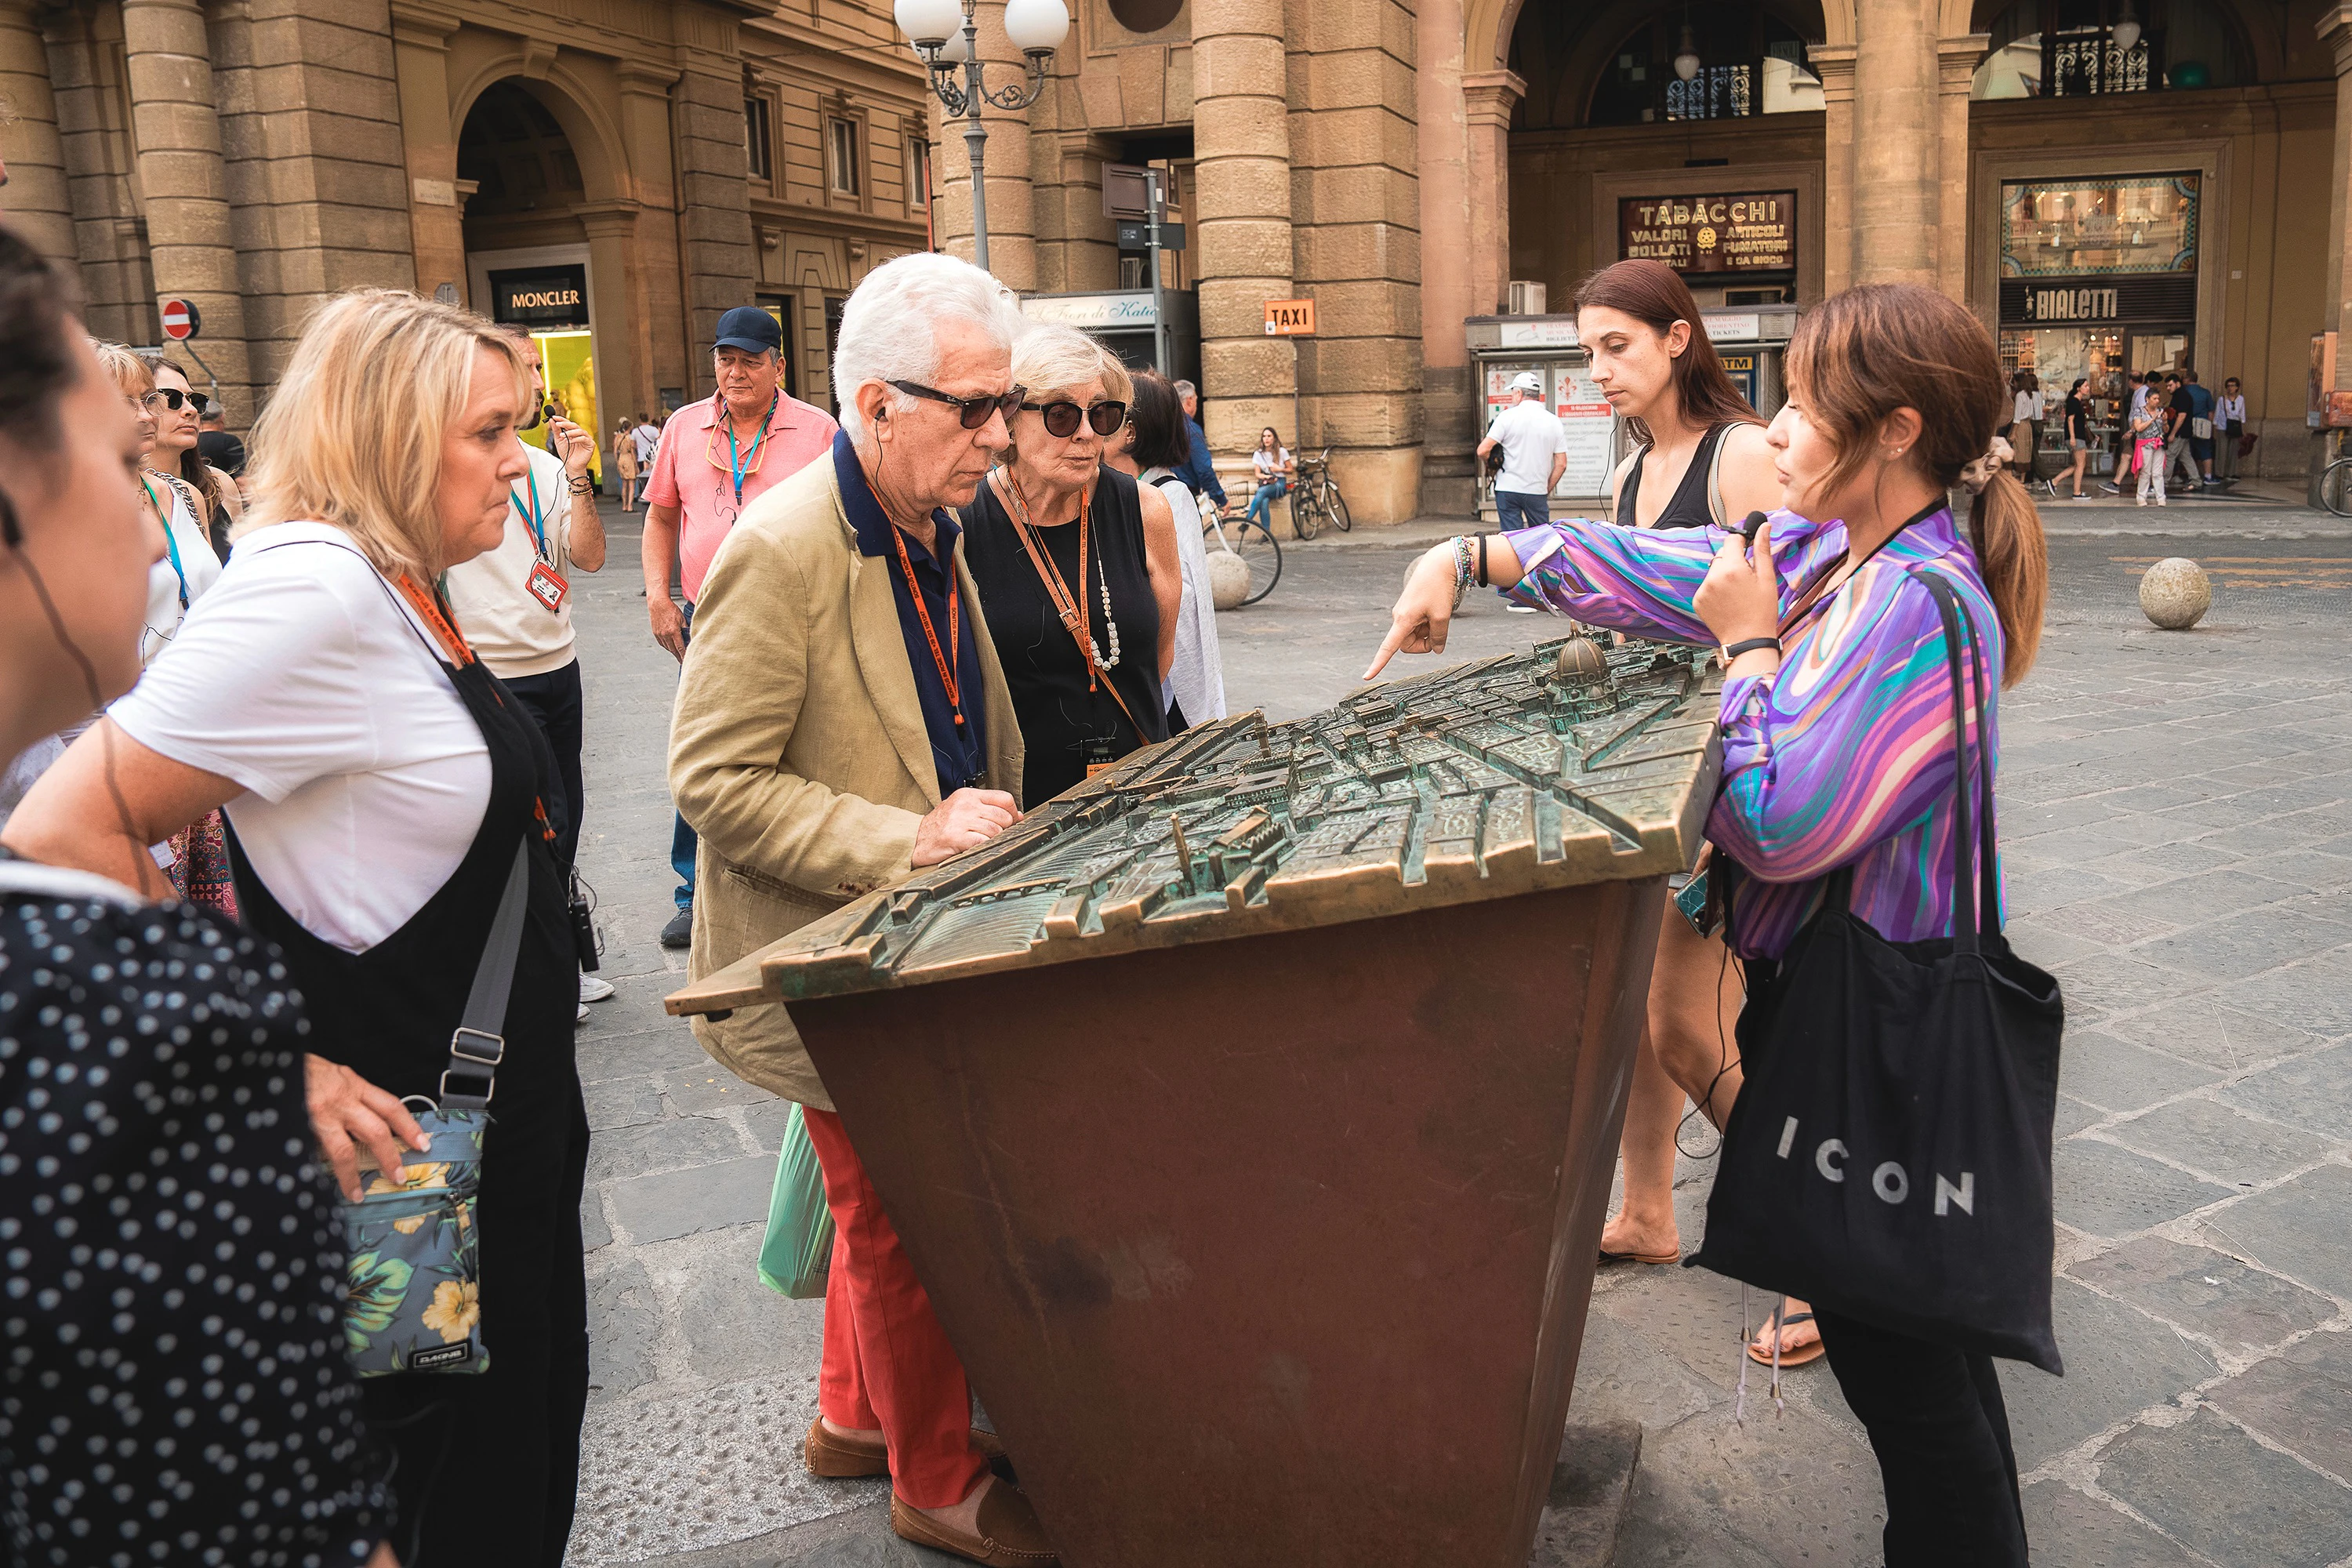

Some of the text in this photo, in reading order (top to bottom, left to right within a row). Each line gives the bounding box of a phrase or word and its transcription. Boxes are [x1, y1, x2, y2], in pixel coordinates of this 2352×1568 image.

[1639, 201, 1776, 226] TABACCHI
[1632, 229, 1686, 242] VALORI
[1726, 224, 1784, 238] ARTICOLI
[1628, 244, 1691, 257] BOLLATI
[1723, 240, 1788, 253] FUMATORI
[1736, 256, 1750, 265] DA
[1752, 256, 1784, 264] GIOCO
[512, 289, 580, 308] MONCLER
[1091, 304, 1106, 319] di
[1272, 308, 1307, 325] TAXI
[900, 554, 910, 571] ROME
[908, 575, 920, 599] SONITUS
[936, 656, 946, 672] ROME
[943, 677, 956, 699] SONITUS
[1777, 1115, 1975, 1216] ICON
